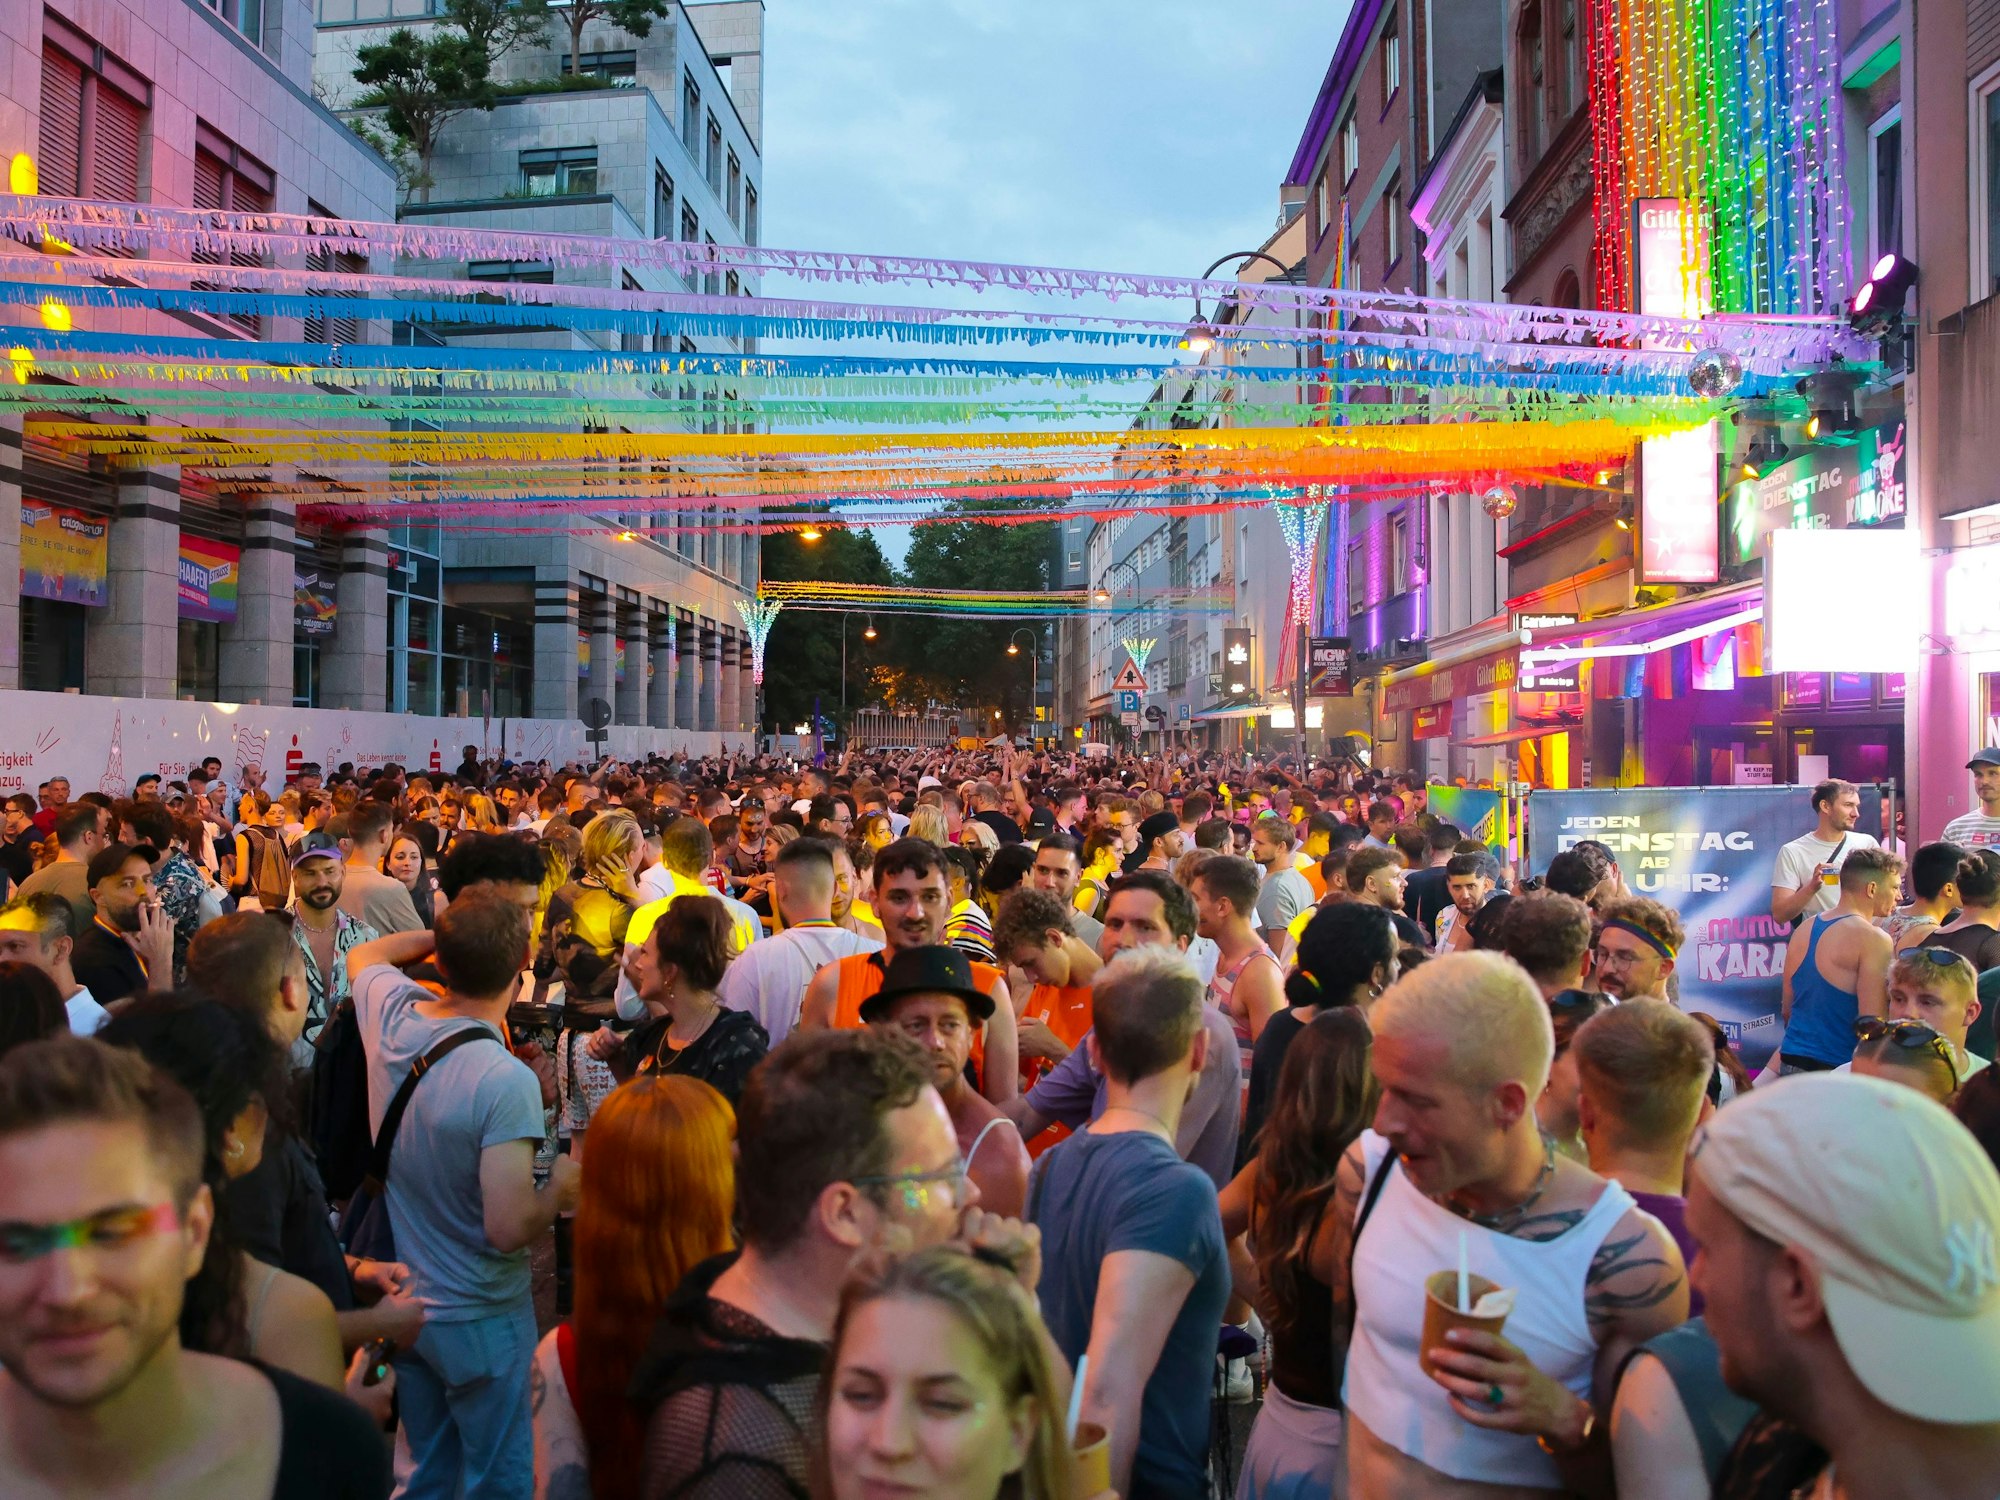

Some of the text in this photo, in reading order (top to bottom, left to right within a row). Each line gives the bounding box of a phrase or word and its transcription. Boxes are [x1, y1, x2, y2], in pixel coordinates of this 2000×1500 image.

[1313, 649, 1347, 661] MGW
[1495, 656, 1516, 682] Kölsch
[1124, 695, 1134, 709] P
[160, 762, 172, 775] Für
[174, 762, 188, 776] Sie,
[1560, 815, 1641, 829] JEDEN
[1640, 856, 1670, 869] AB
[1635, 873, 1729, 893] UHR:
[1743, 1015, 1773, 1032] STRASSE
